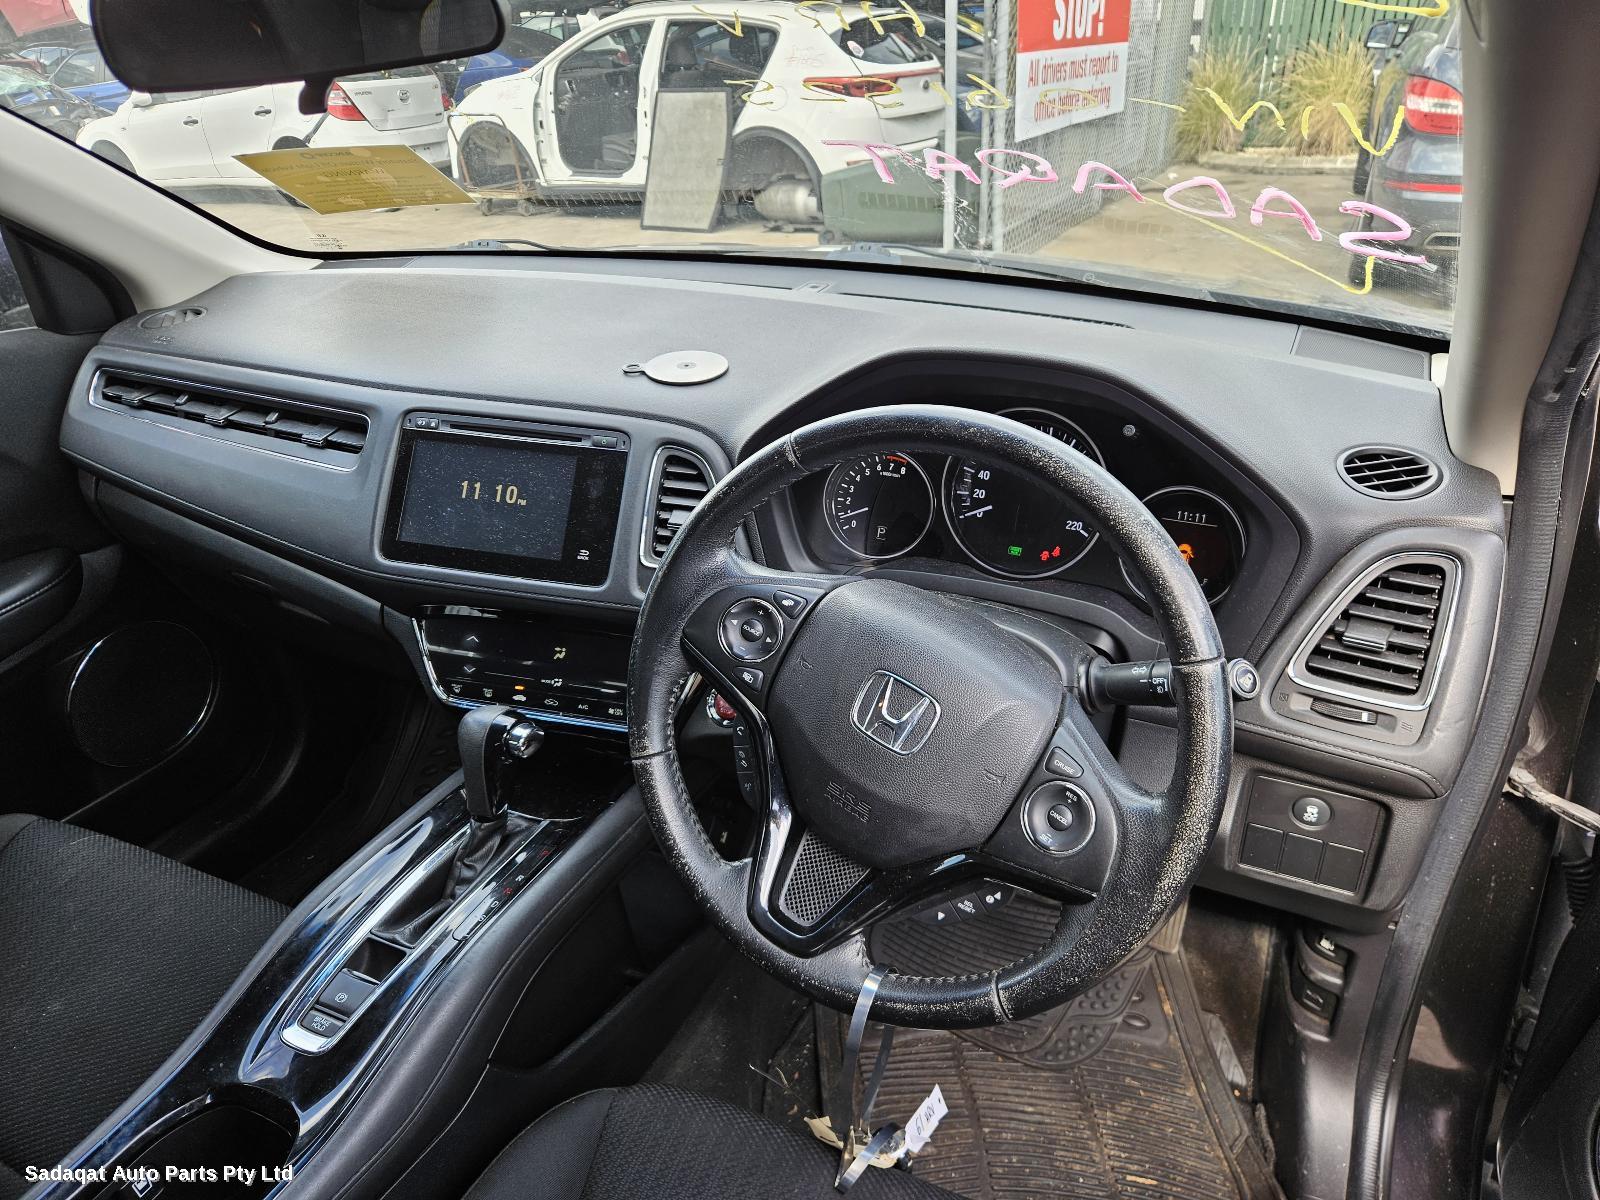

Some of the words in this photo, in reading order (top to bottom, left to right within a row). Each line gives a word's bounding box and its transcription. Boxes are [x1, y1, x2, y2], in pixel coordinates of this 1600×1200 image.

[1028, 59, 1040, 88] All
[1041, 56, 1067, 85] drivers
[1068, 53, 1088, 80] must
[1088, 52, 1111, 80] report
[1111, 50, 1119, 73] to
[865, 468, 871, 476] 5
[900, 466, 906, 475] 8
[978, 470, 991, 481] 40
[973, 488, 986, 499] 20
[845, 496, 851, 505] 2
[1177, 510, 1207, 524] 11:11
[851, 520, 857, 528] 0
[1065, 520, 1083, 531] 220
[1054, 759, 1076, 775] CRUISE
[1065, 790, 1078, 802] RES
[1049, 810, 1069, 826] CANCEL
[313, 1015, 332, 1027] BRAKE
